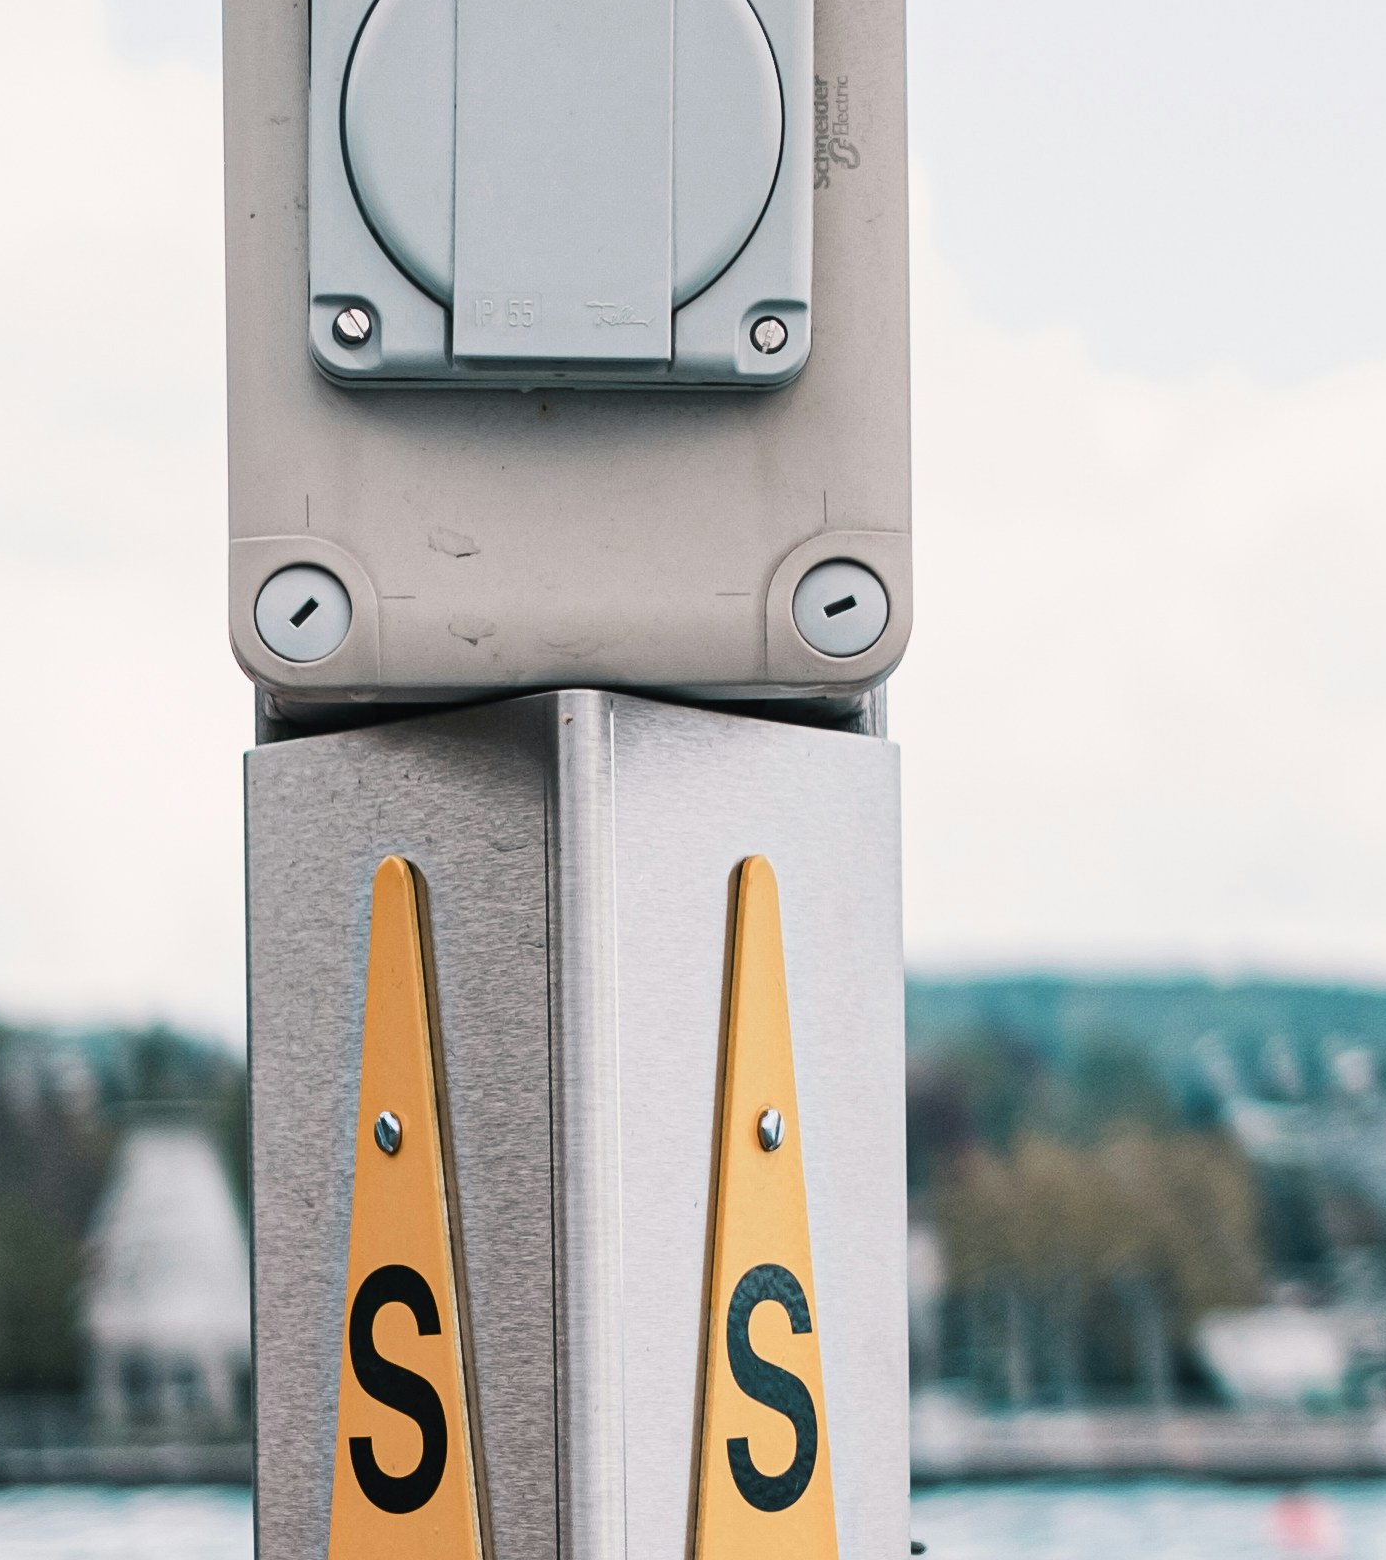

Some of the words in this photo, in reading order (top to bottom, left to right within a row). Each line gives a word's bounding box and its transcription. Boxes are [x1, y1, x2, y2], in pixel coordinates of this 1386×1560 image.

[813, 74, 830, 189] Schneider
[832, 75, 849, 135] Electric
[474, 300, 494, 327] IP
[508, 299, 534, 327] 55
